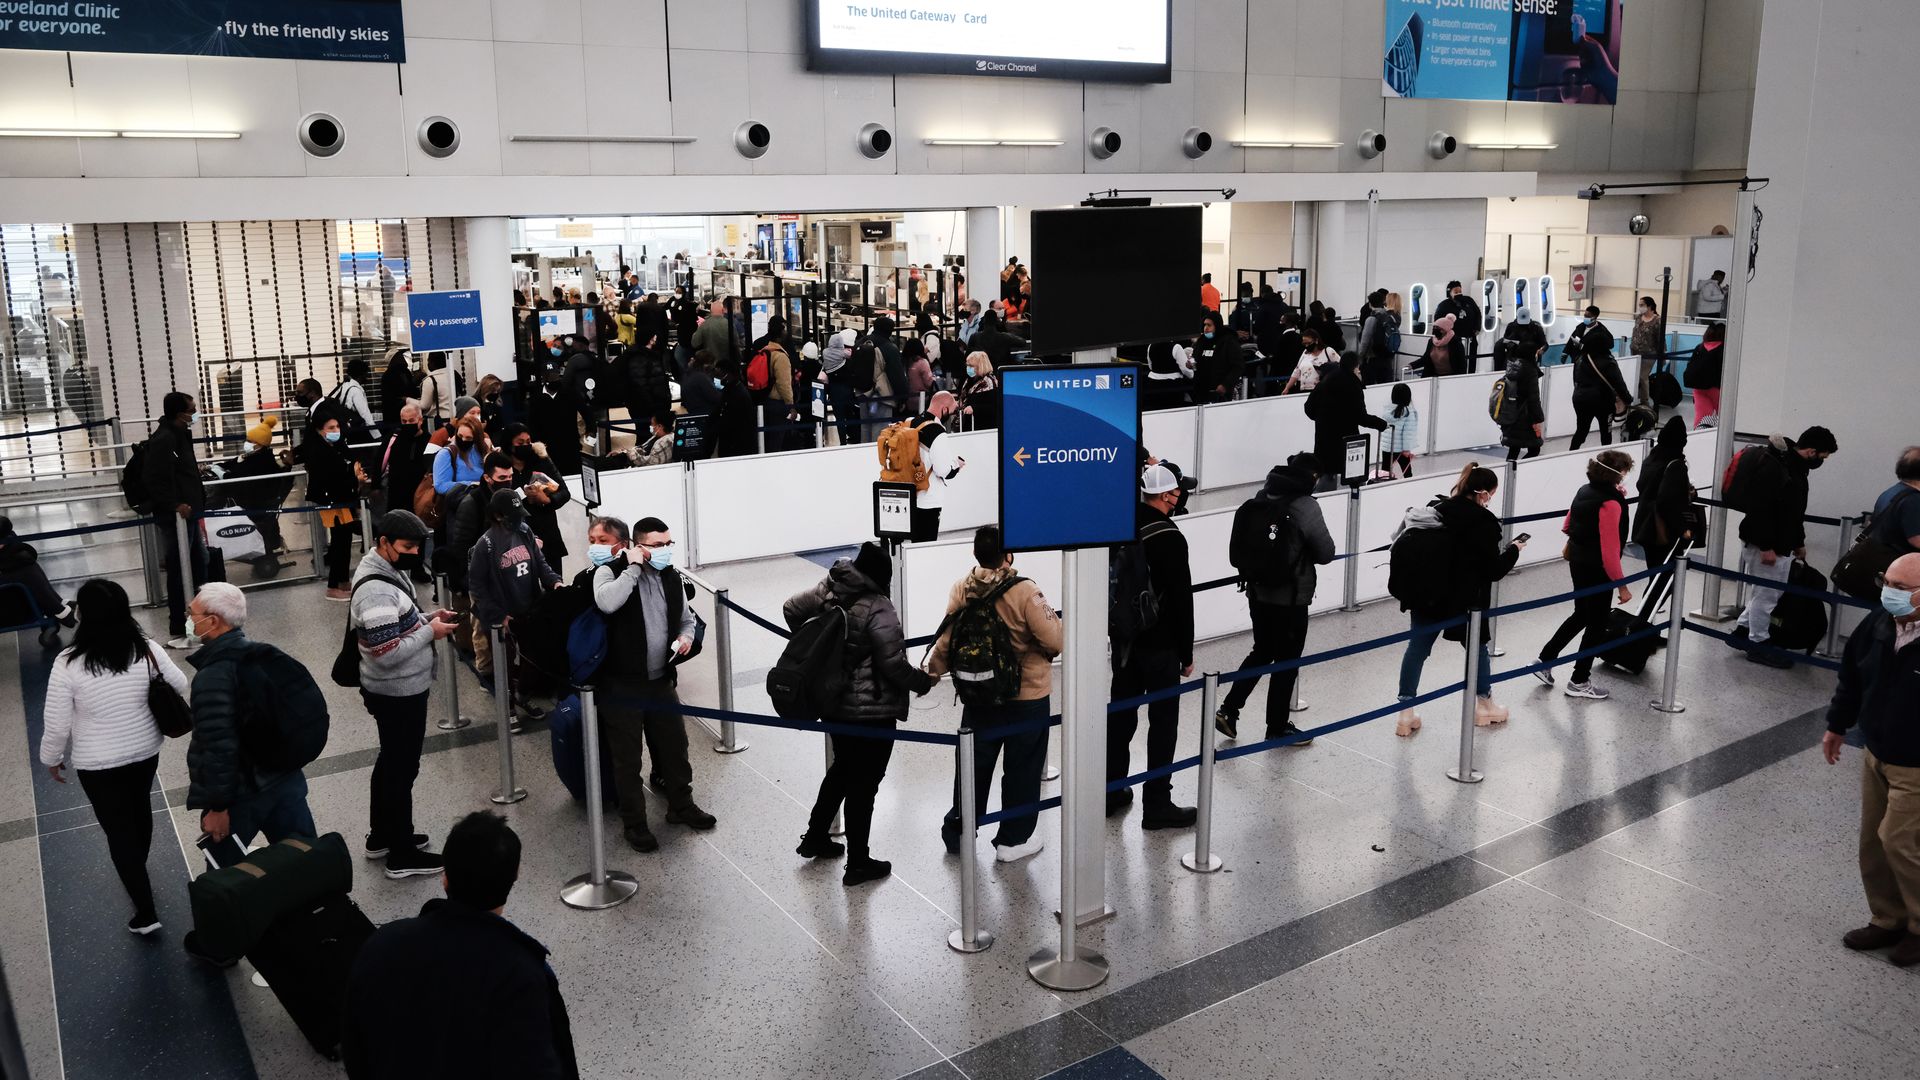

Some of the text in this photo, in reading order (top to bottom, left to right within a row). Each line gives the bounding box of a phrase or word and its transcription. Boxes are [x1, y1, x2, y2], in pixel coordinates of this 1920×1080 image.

[74, 3, 120, 19] Clinic
[847, 5, 987, 24] The United Gateway Card
[1514, 0, 1558, 15] sense:
[18, 20, 106, 35] everyone.
[224, 20, 389, 42] fly the friendly skies
[1432, 18, 1497, 32] Bluetooth connectivity
[1452, 34, 1472, 43] power
[1479, 36, 1495, 45] every
[1496, 36, 1508, 45] seat
[1431, 45, 1492, 56] Larger overhead bins
[987, 62, 1037, 72] Clear Channel
[1431, 55, 1497, 68] for everyone's carry-on
[440, 316, 478, 327] passengers
[1033, 379, 1092, 390] UNITED
[1037, 447, 1118, 464] Economy
[234, 526, 252, 534] NAVY
[516, 562, 529, 577] R
